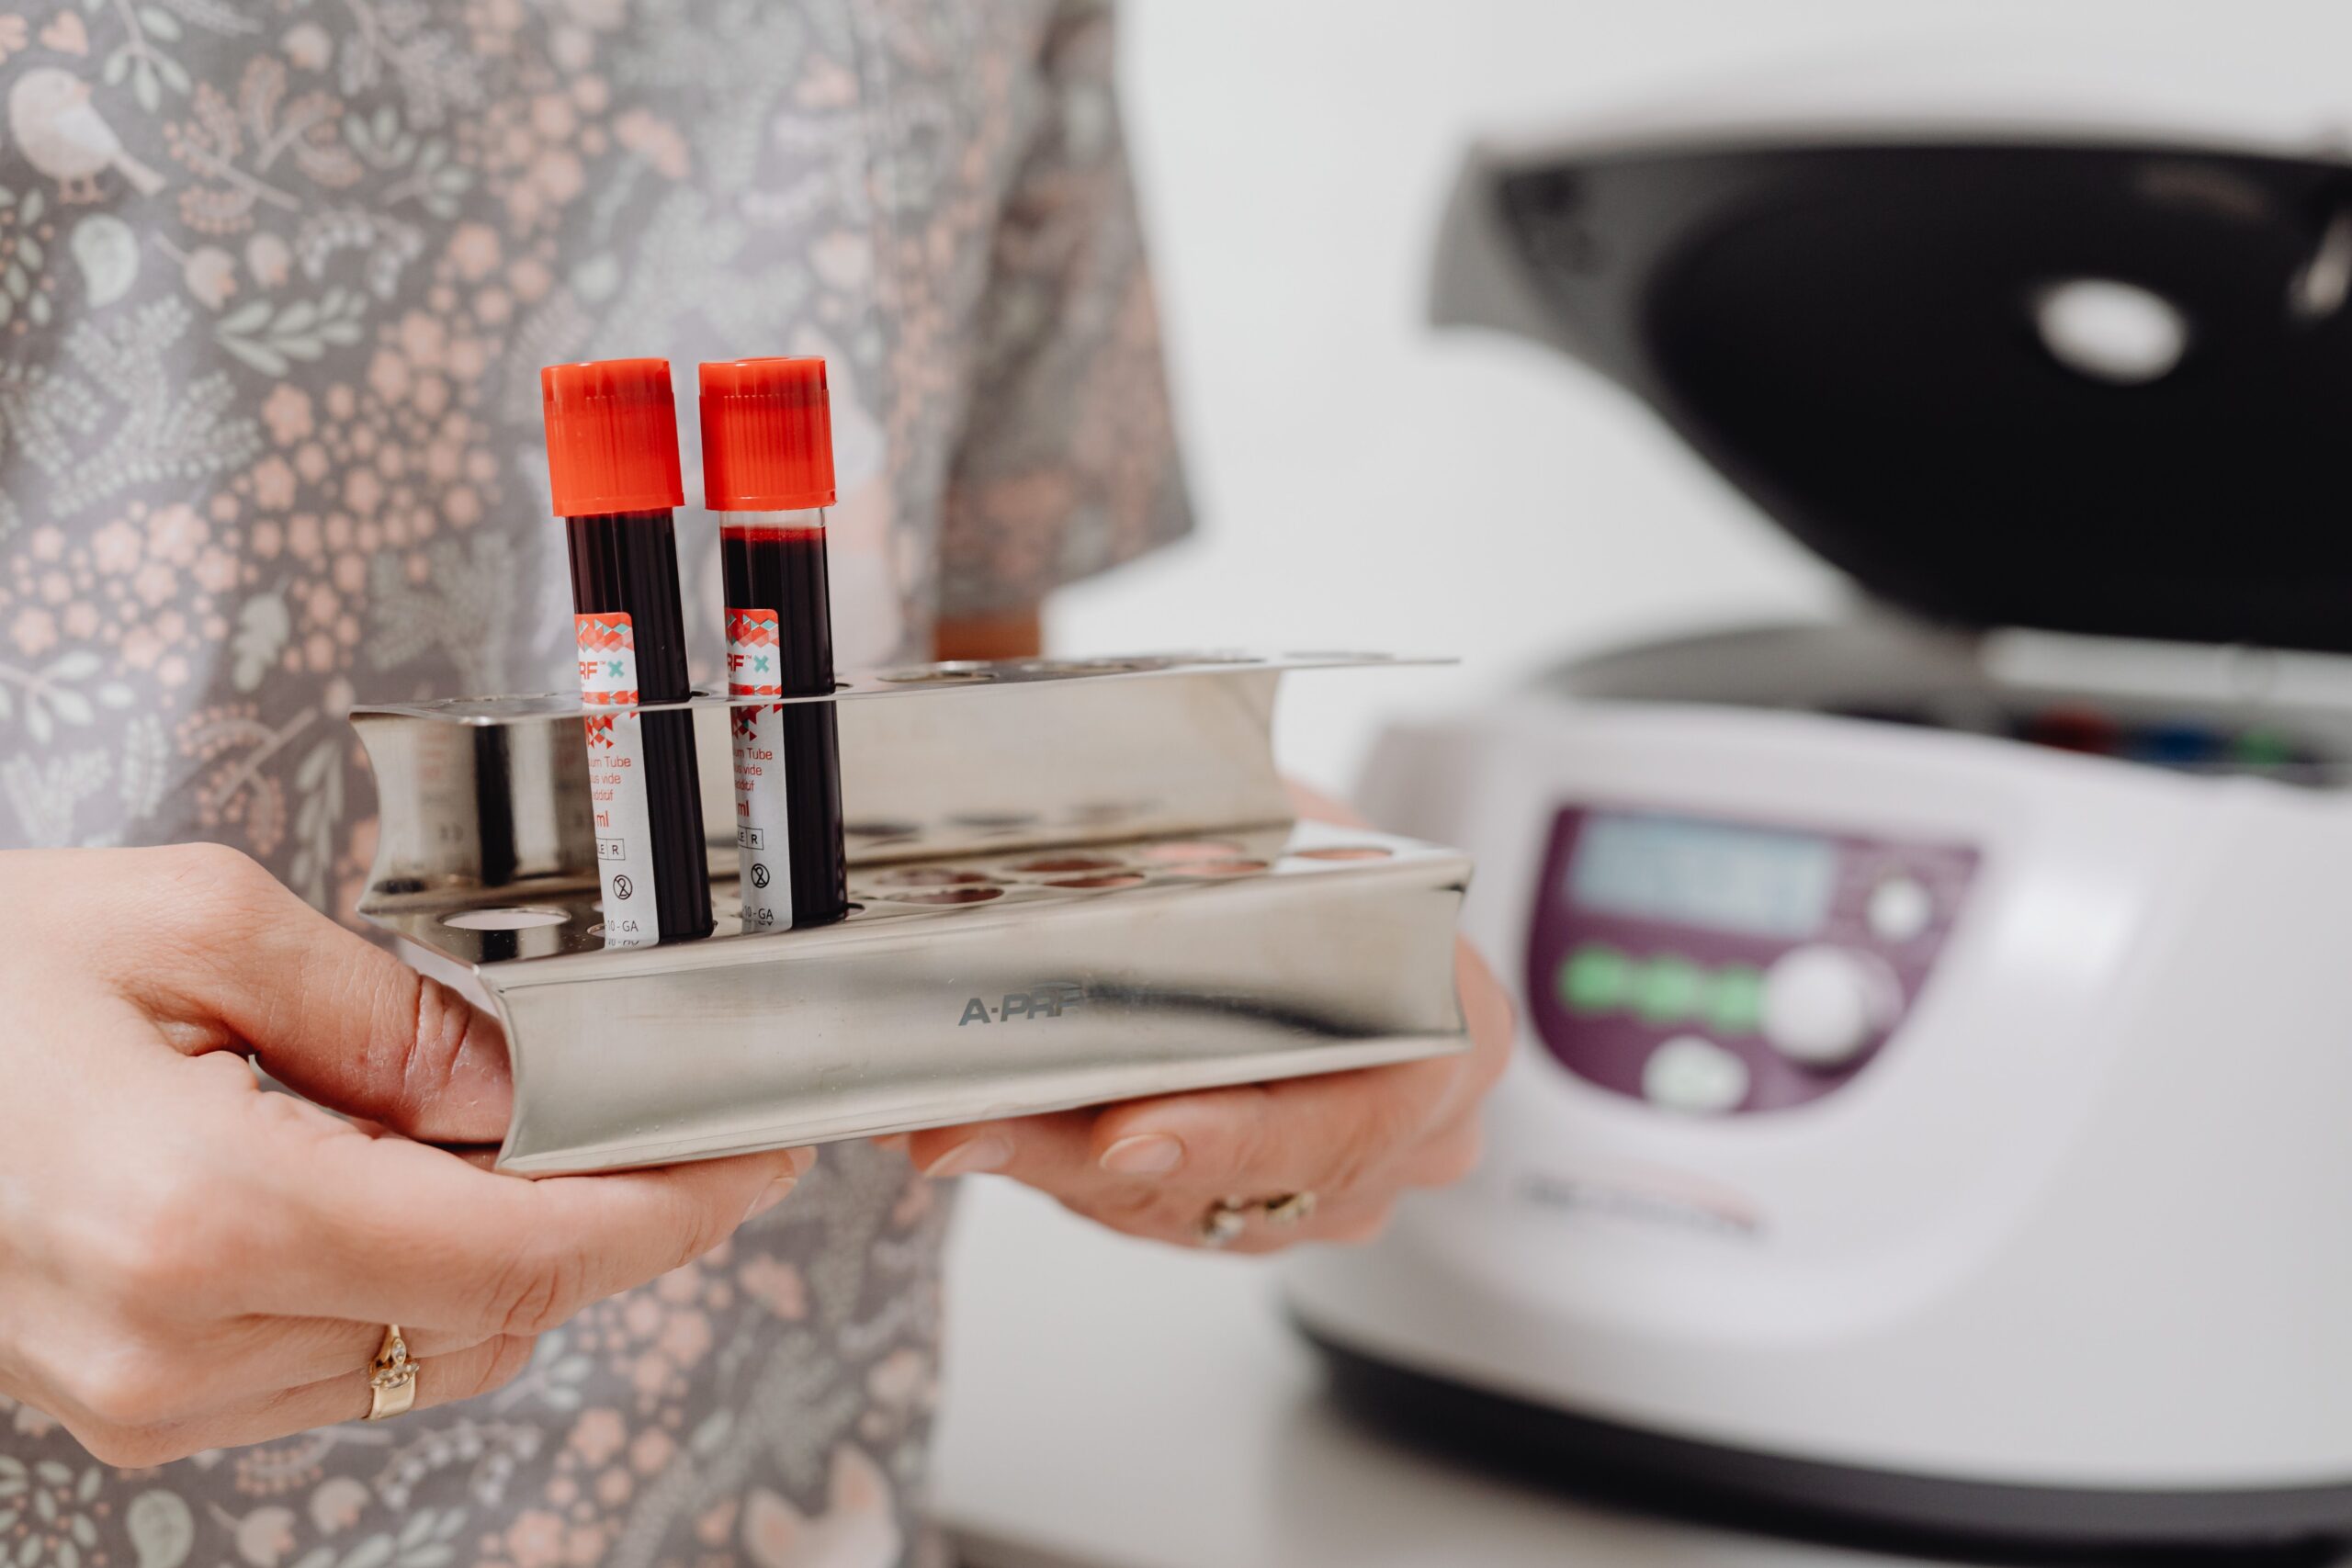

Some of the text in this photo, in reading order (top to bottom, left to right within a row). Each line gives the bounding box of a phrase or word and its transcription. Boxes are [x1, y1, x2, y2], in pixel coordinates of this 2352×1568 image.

[746, 747, 773, 761] Tube
[604, 755, 632, 768] Tube
[743, 763, 763, 776] vide
[602, 773, 622, 784] vide
[736, 798, 751, 818] ml
[596, 810, 610, 827] ml
[751, 834, 758, 844] R
[612, 844, 619, 855] R
[758, 908, 774, 920] GA
[622, 919, 639, 932] GA
